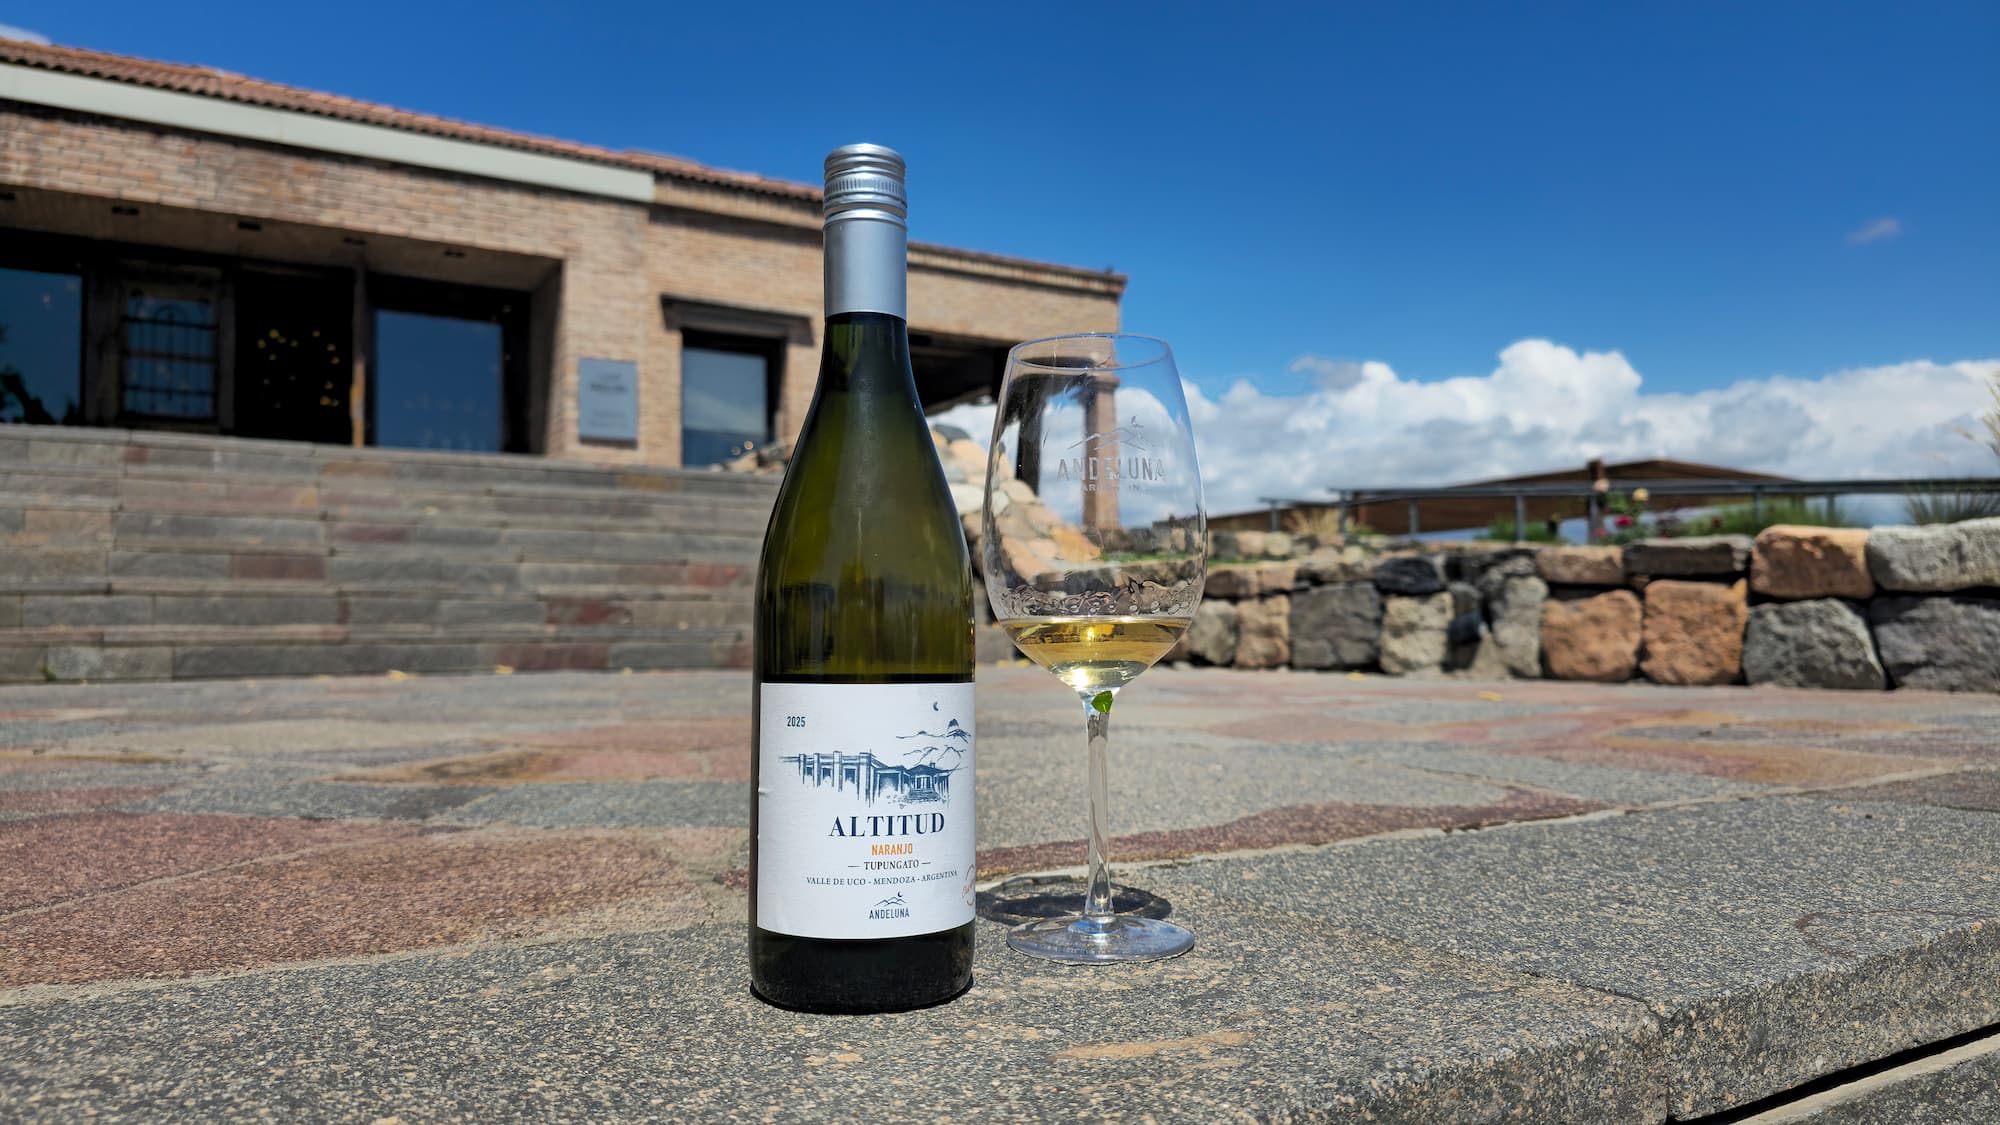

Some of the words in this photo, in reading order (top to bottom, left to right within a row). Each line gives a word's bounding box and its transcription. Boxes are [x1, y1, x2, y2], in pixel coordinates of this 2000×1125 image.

[787, 716, 806, 727] 2025
[828, 812, 945, 837] ALTITUD
[871, 843, 913, 855] NARANJO
[864, 859, 919, 870] TUPUNGATO
[806, 876, 831, 885] VALLE
[847, 878, 866, 886] UCO
[873, 876, 916, 885] MENDOZA
[921, 870, 958, 882] ARGENTINA
[869, 908, 910, 920] ANDELUNA
